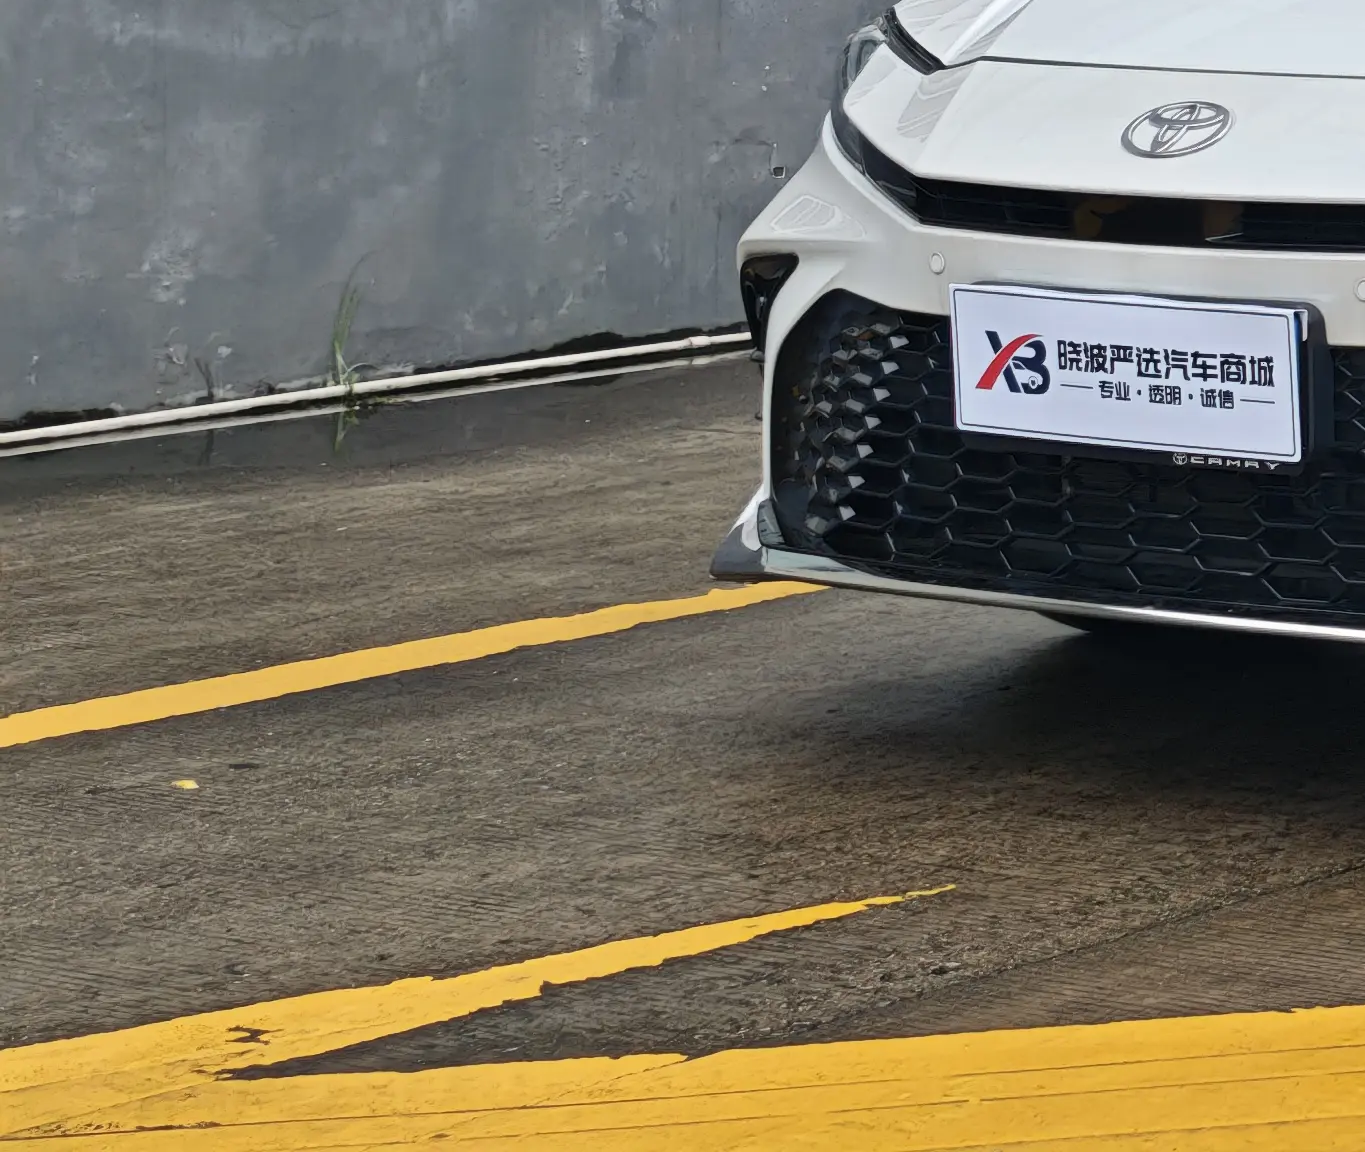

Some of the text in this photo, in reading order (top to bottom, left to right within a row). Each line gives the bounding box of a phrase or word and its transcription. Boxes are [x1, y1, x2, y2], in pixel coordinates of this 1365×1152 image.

[1056, 338, 1276, 388] 晓波严选汽车商城
